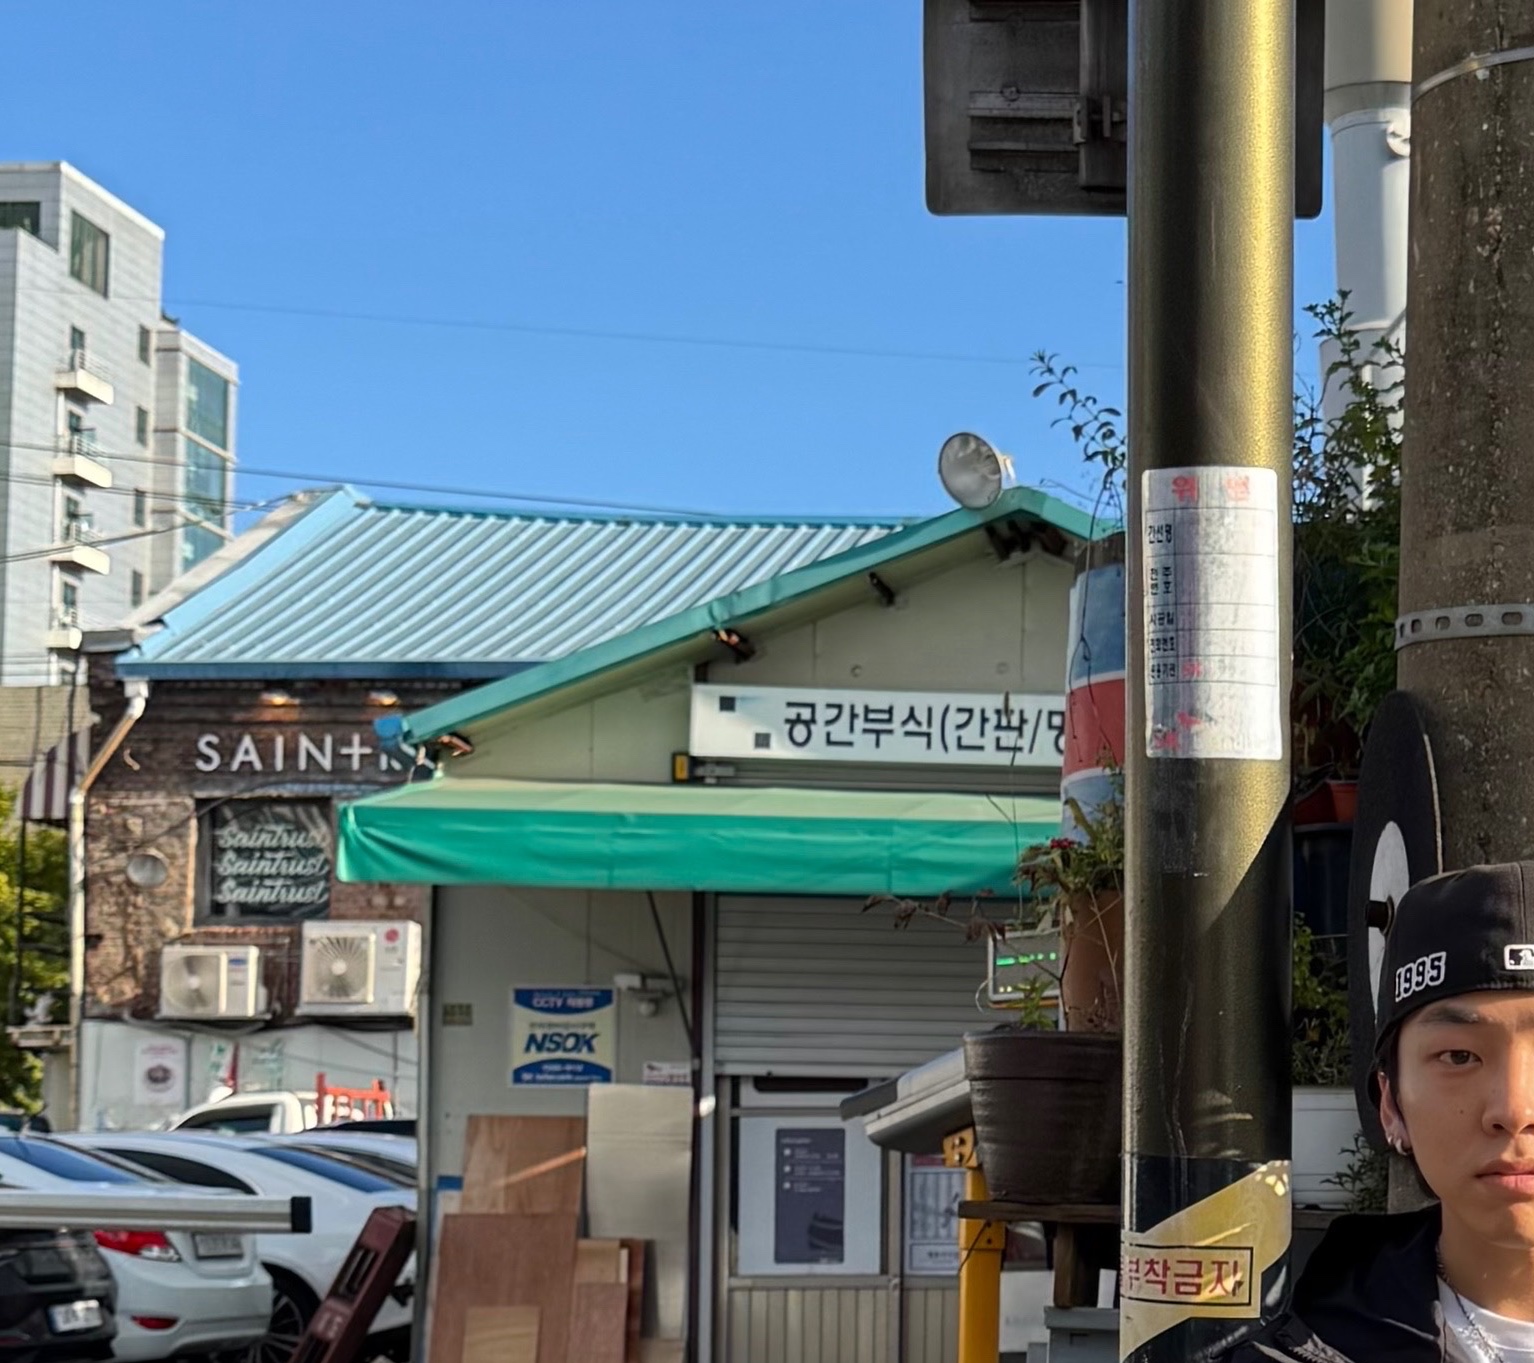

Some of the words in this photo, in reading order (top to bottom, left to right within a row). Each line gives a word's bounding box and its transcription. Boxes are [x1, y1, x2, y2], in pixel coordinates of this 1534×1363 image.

[214, 878, 329, 904] Saintrust
[1395, 951, 1447, 1002] 1995
[524, 1032, 601, 1054] NSOK
